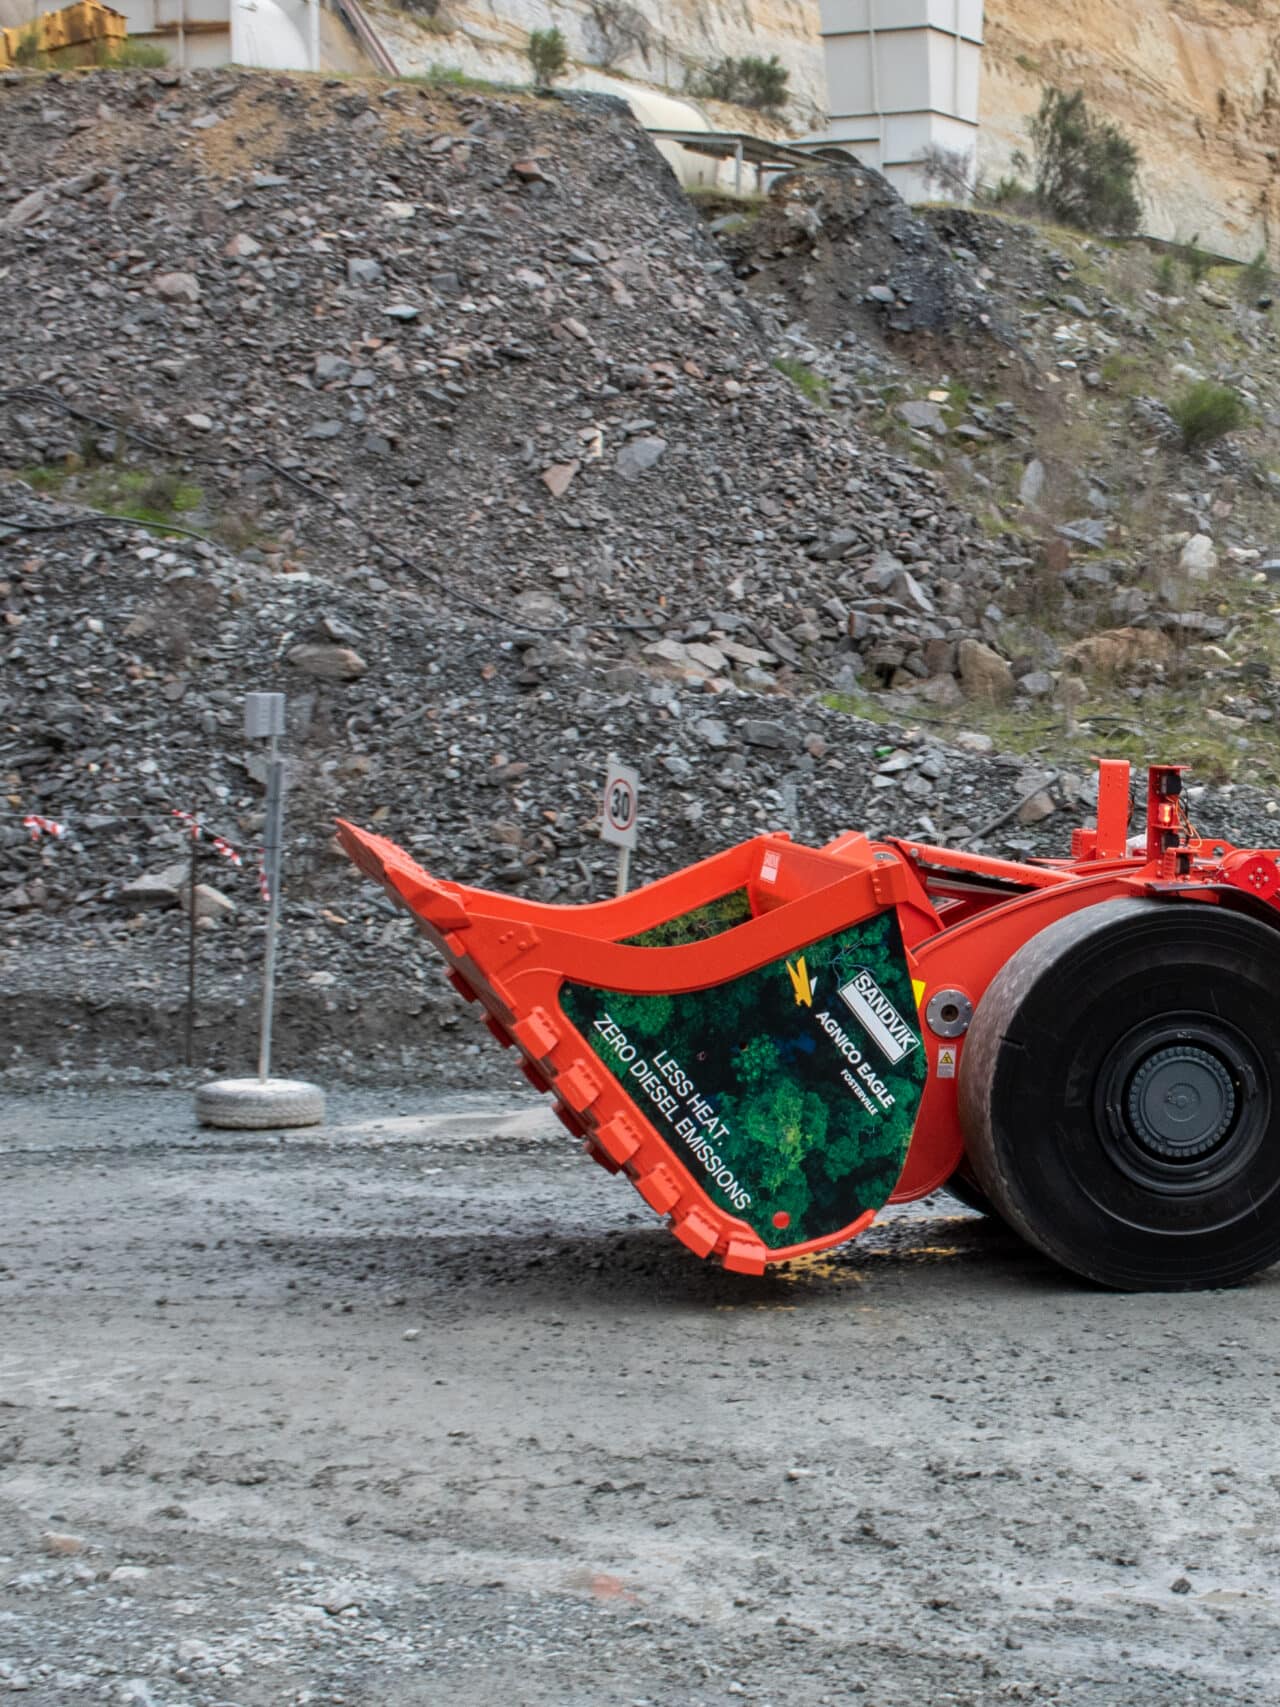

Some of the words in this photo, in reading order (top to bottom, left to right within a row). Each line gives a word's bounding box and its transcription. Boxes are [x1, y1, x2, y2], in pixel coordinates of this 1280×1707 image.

[612, 788, 630, 822] 30
[855, 974, 916, 1052] SANDVIK
[652, 1050, 694, 1097] LESS
[686, 1093, 730, 1147] HEAT.
[815, 1011, 862, 1064] AGNICO
[856, 1062, 896, 1109] EAGLE
[840, 1068, 879, 1116] FOSTERVILLE
[593, 1013, 637, 1062] ZERO
[629, 1059, 680, 1122] DIESEL
[675, 1117, 752, 1210] EMISSIONS
